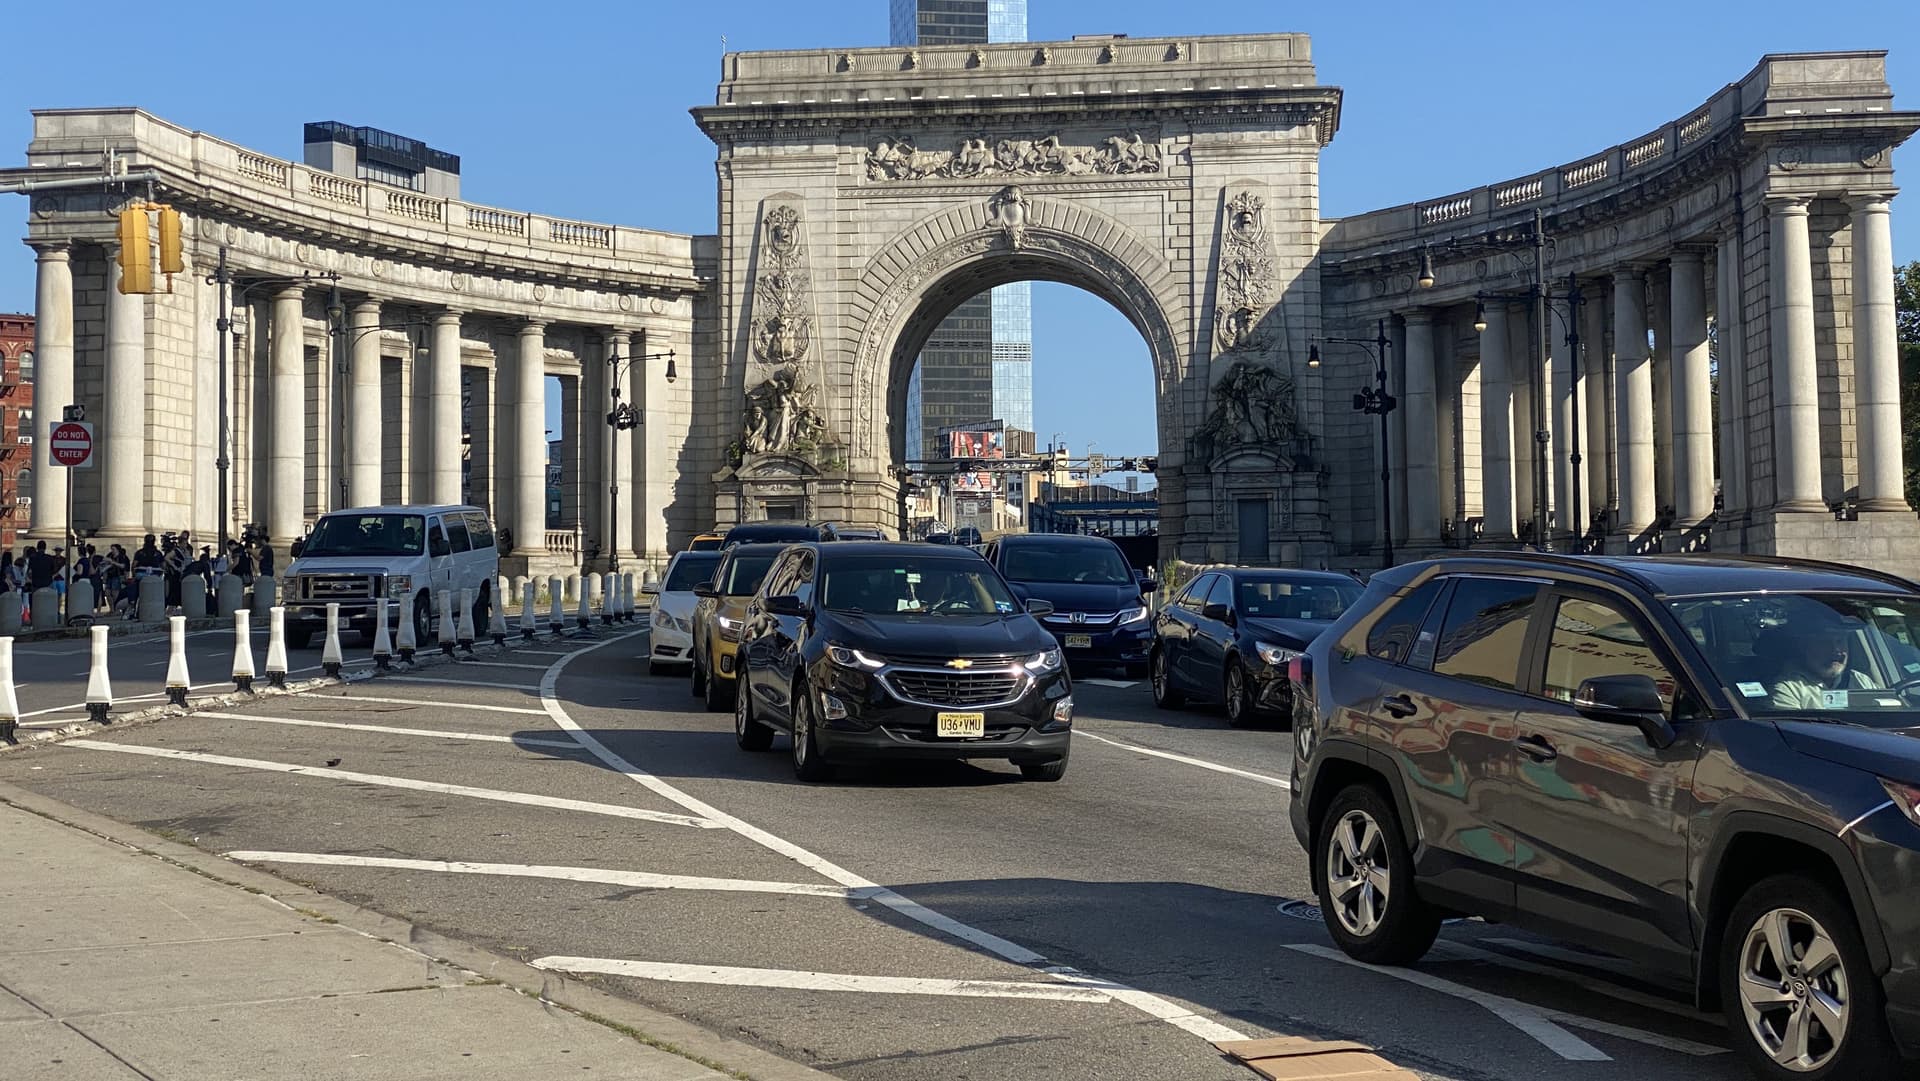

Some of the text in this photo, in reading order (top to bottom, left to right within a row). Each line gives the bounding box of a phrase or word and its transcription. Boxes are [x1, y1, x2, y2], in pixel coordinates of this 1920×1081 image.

[57, 431, 85, 440] DO NOT
[59, 450, 83, 458] ENTER
[940, 719, 958, 730] U36
